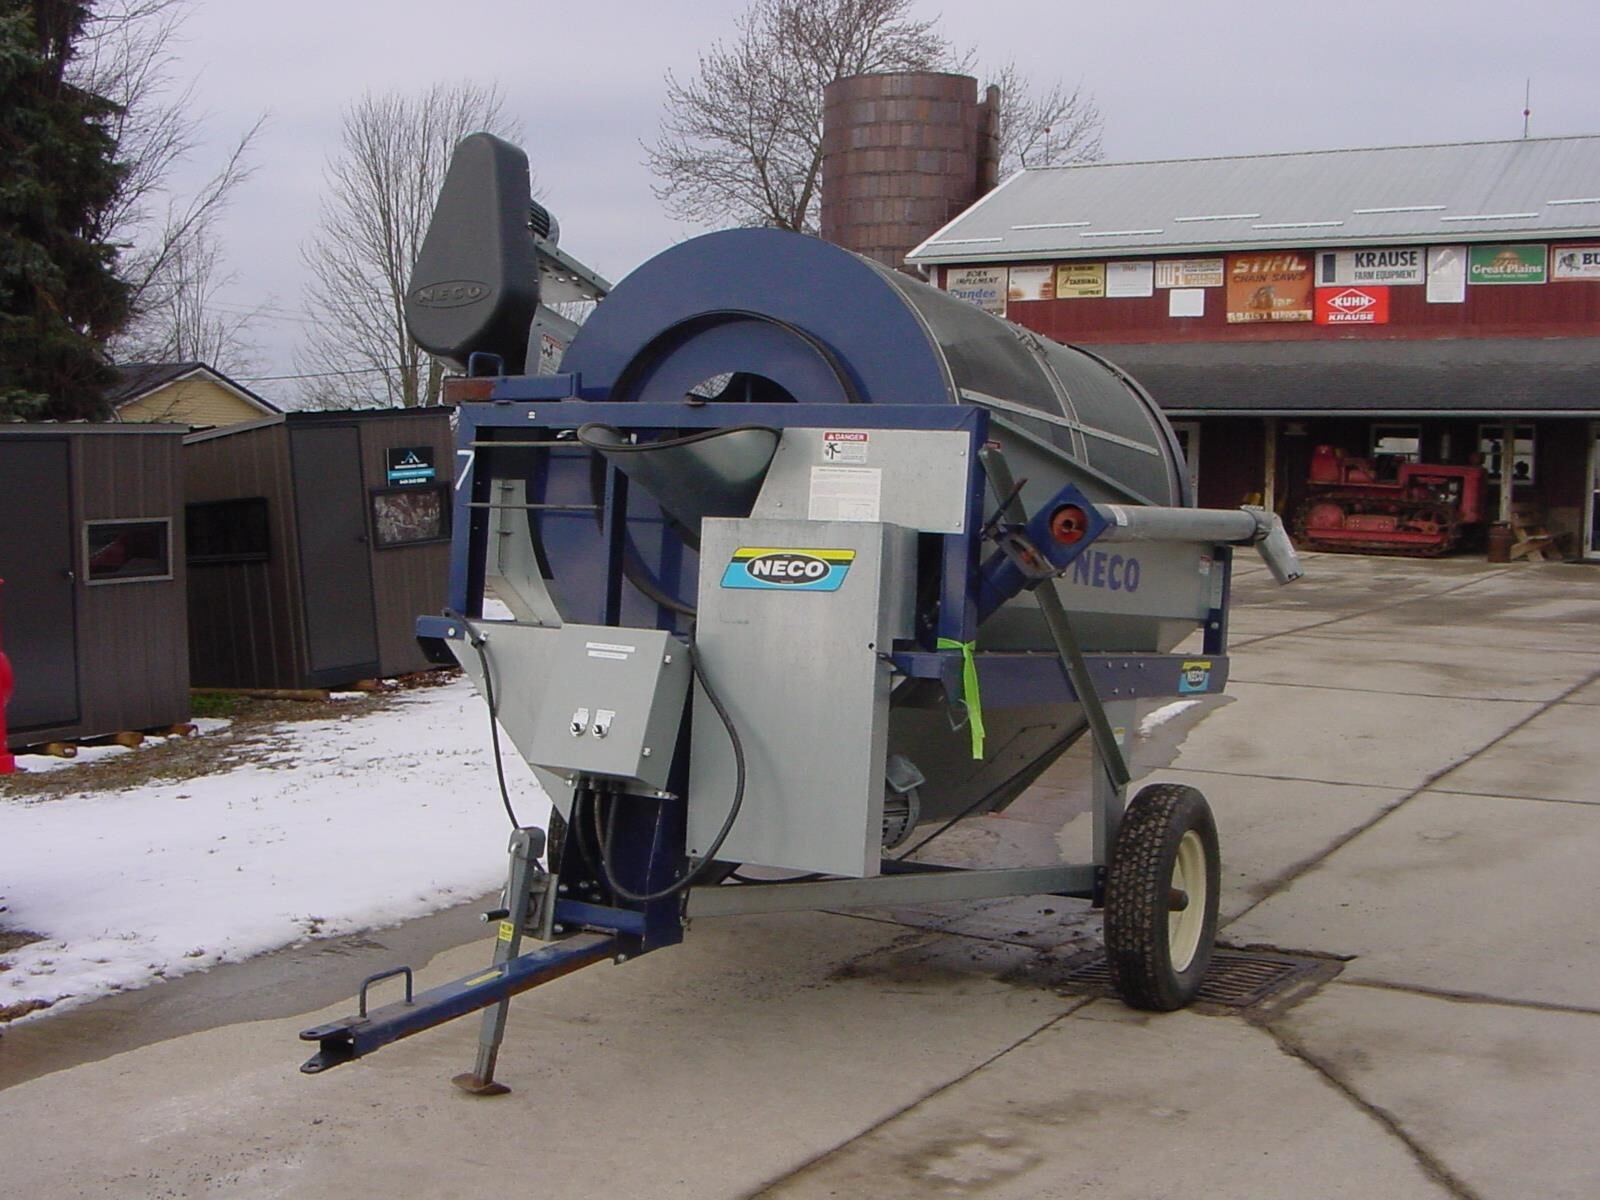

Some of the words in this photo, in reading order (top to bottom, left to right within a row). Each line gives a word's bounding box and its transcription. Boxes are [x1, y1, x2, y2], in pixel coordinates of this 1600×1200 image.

[1233, 255, 1307, 273] STIHL
[1354, 251, 1418, 268] KRAUSE
[1471, 263, 1504, 274] Great
[1506, 263, 1542, 274] Plains
[1233, 273, 1268, 282] CHAIN
[1272, 271, 1305, 281] SAWS
[1354, 271, 1375, 280] FARM
[1375, 269, 1417, 281] EQUIPMENT
[418, 287, 482, 303] NECO
[1334, 296, 1369, 307] KUHN
[1328, 313, 1375, 321] KRAUSE
[834, 433, 866, 441] DANGER
[752, 559, 825, 578] NECO
[1072, 549, 1141, 593] NECO
[1186, 671, 1205, 683] NECO
